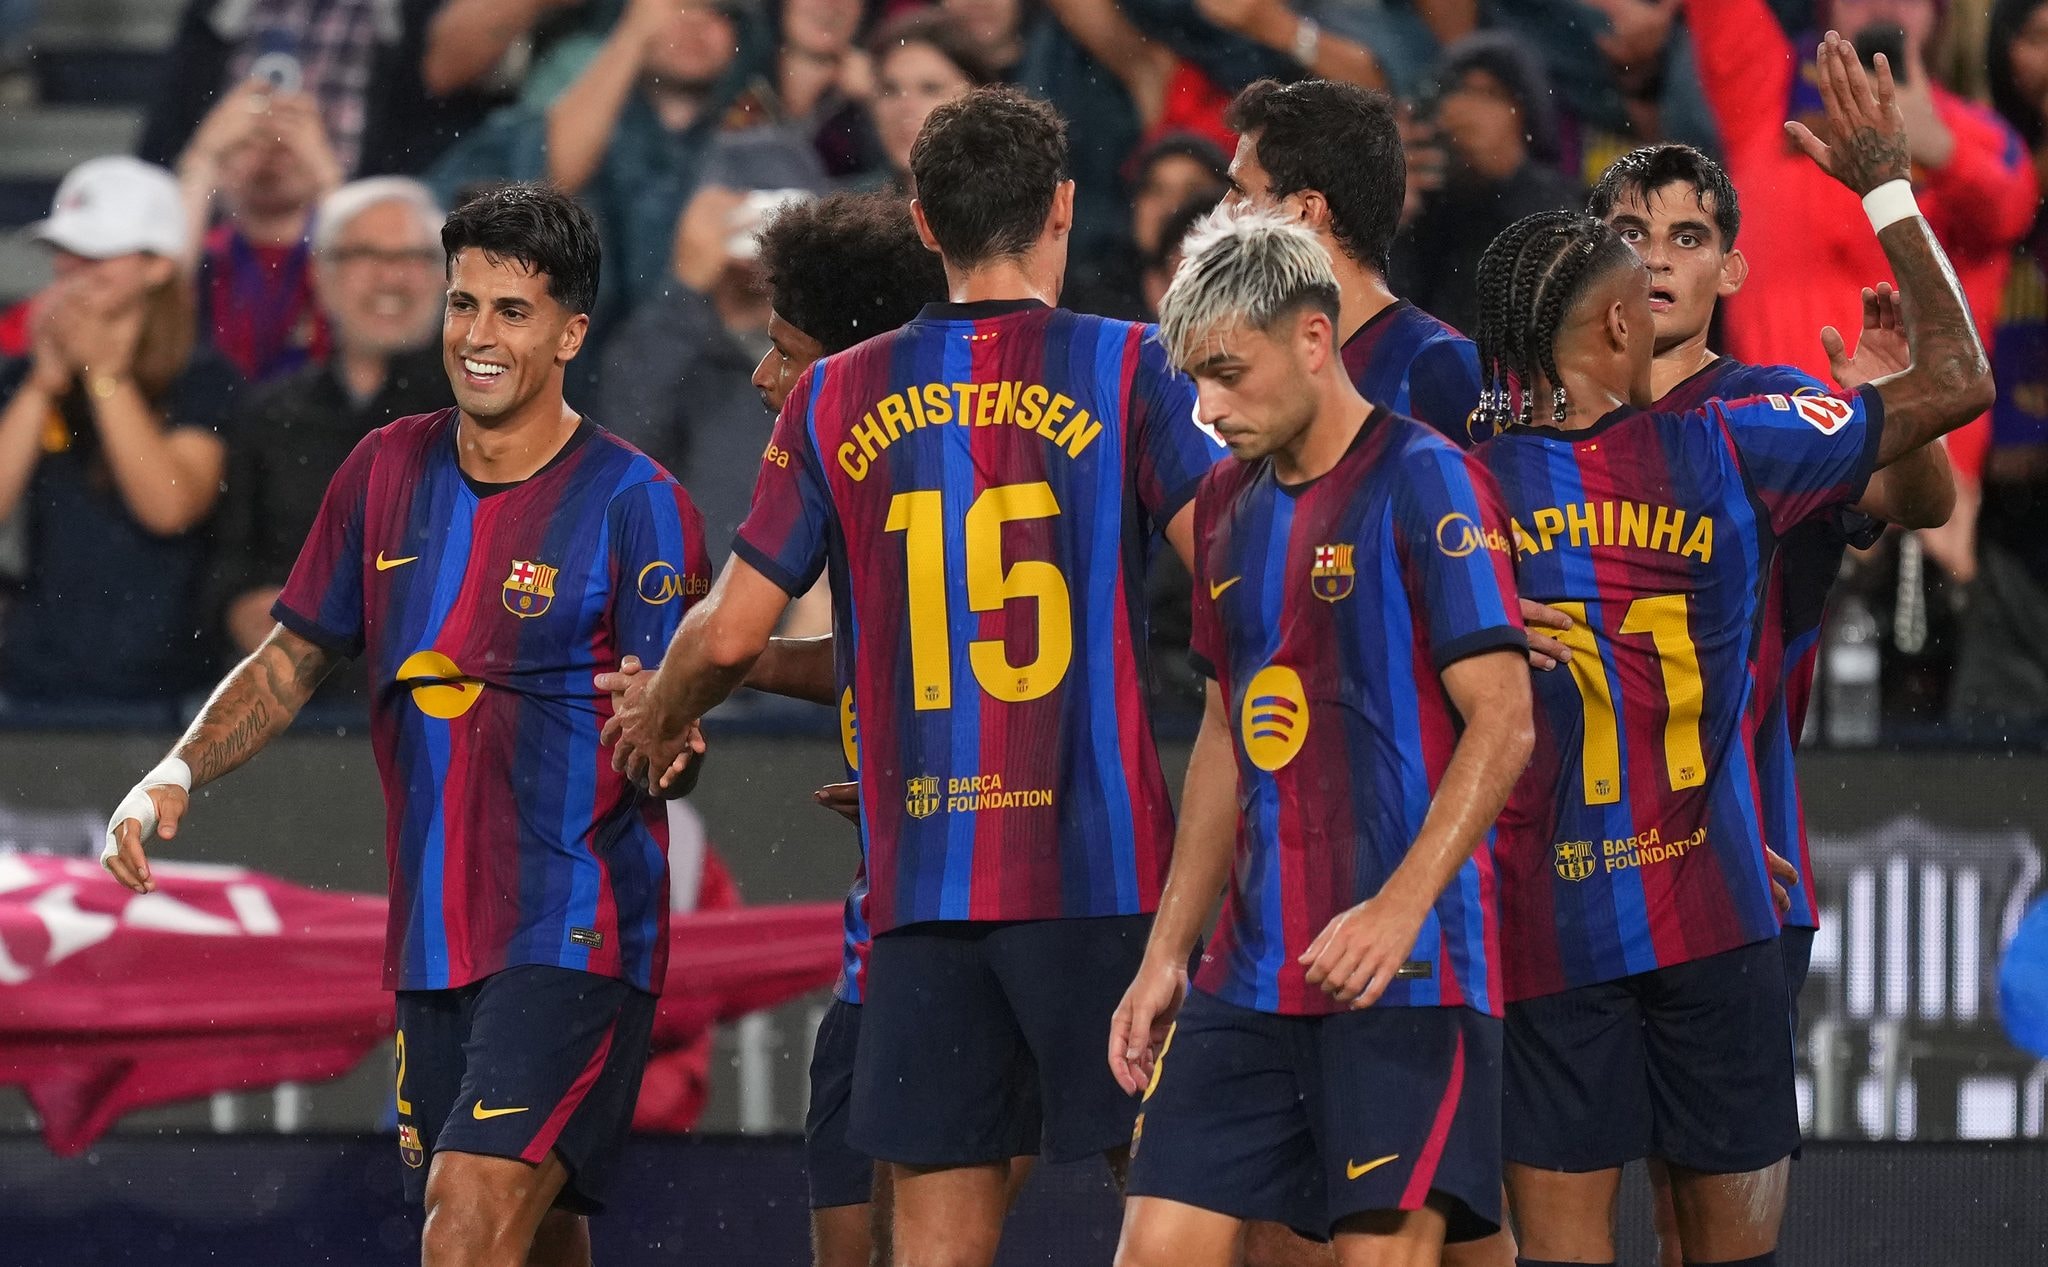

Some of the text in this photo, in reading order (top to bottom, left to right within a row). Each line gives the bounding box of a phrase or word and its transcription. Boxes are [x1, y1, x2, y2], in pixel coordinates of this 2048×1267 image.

[837, 381, 1103, 482] CHRISTENSEN
[1511, 501, 1713, 564] APHINHA
[518, 583, 539, 594] FCB
[884, 481, 1073, 711] 15
[1528, 594, 1707, 806] 11
[947, 789, 1053, 813] FOUNDATION
[948, 773, 1002, 794] BARÇA
[1602, 828, 1661, 857] BARÇA
[1604, 826, 1708, 874] FOUNDATION
[396, 1029, 412, 1116] 2
